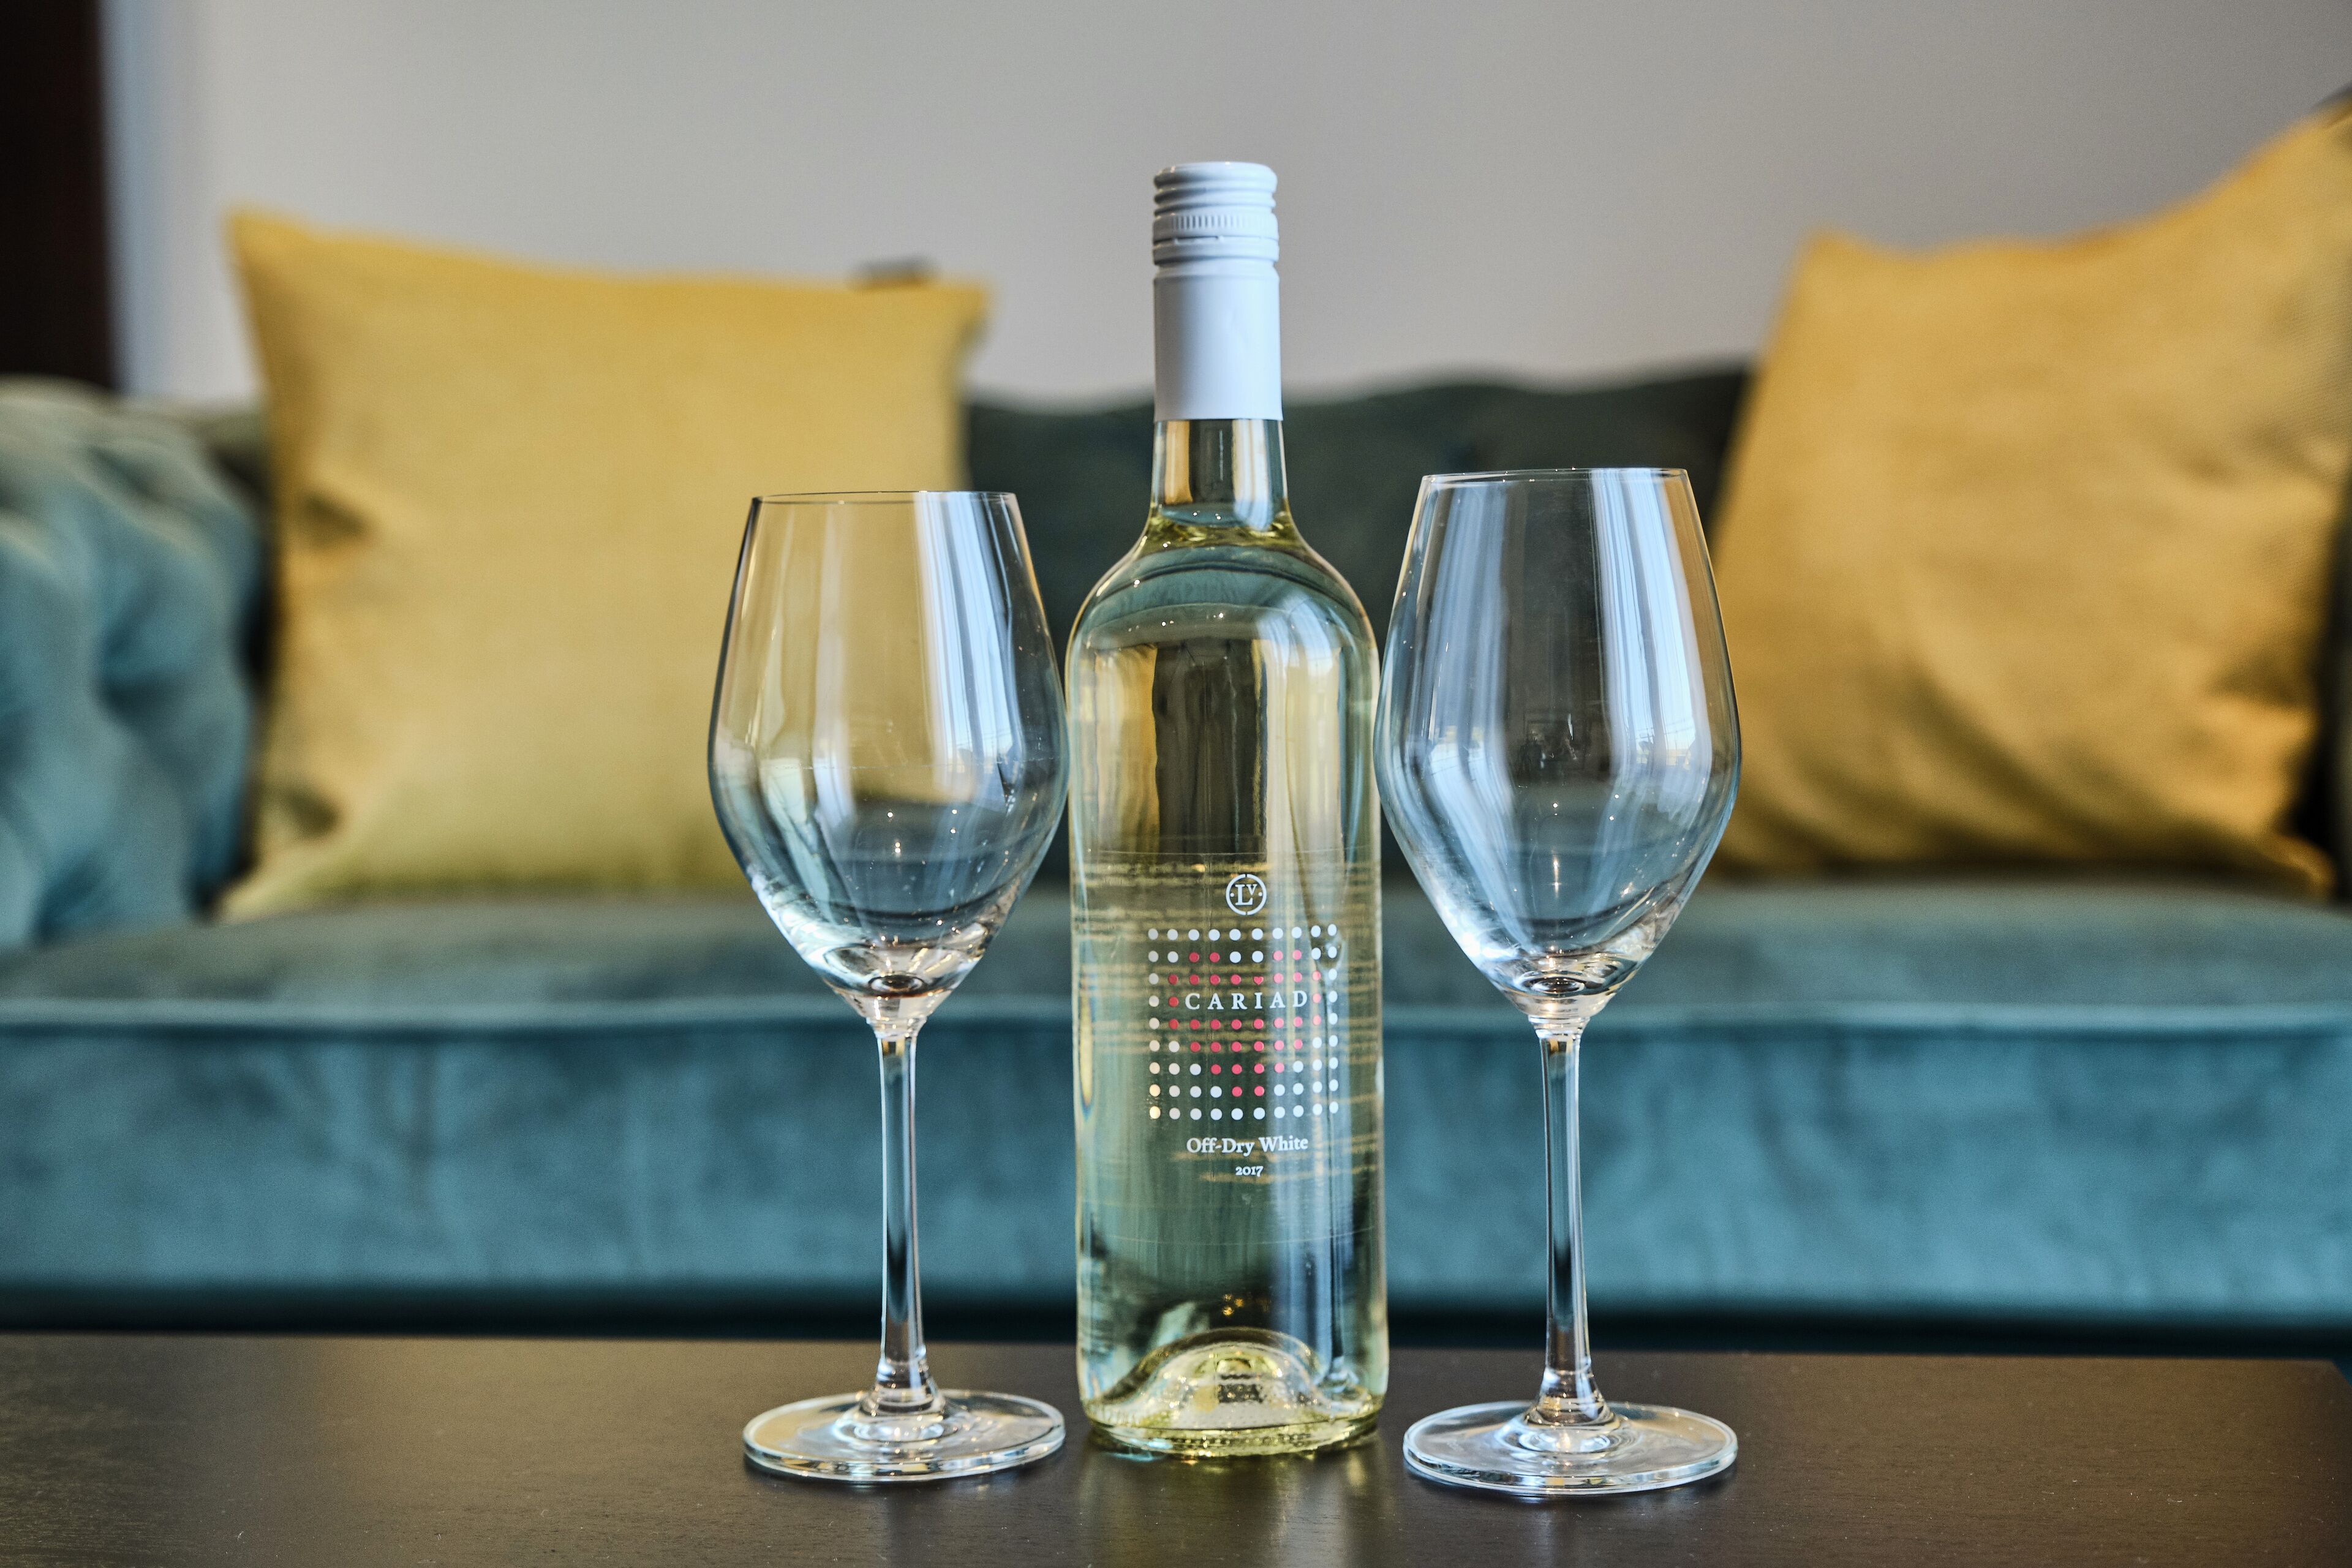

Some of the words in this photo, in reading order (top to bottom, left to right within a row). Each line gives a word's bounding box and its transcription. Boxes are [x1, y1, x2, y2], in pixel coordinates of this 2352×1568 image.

[1185, 990, 1308, 1010] CARIAD
[1186, 1137, 1255, 1156] Off-Dry
[1257, 1136, 1309, 1152] White
[1235, 1166, 1264, 1177] 2017
